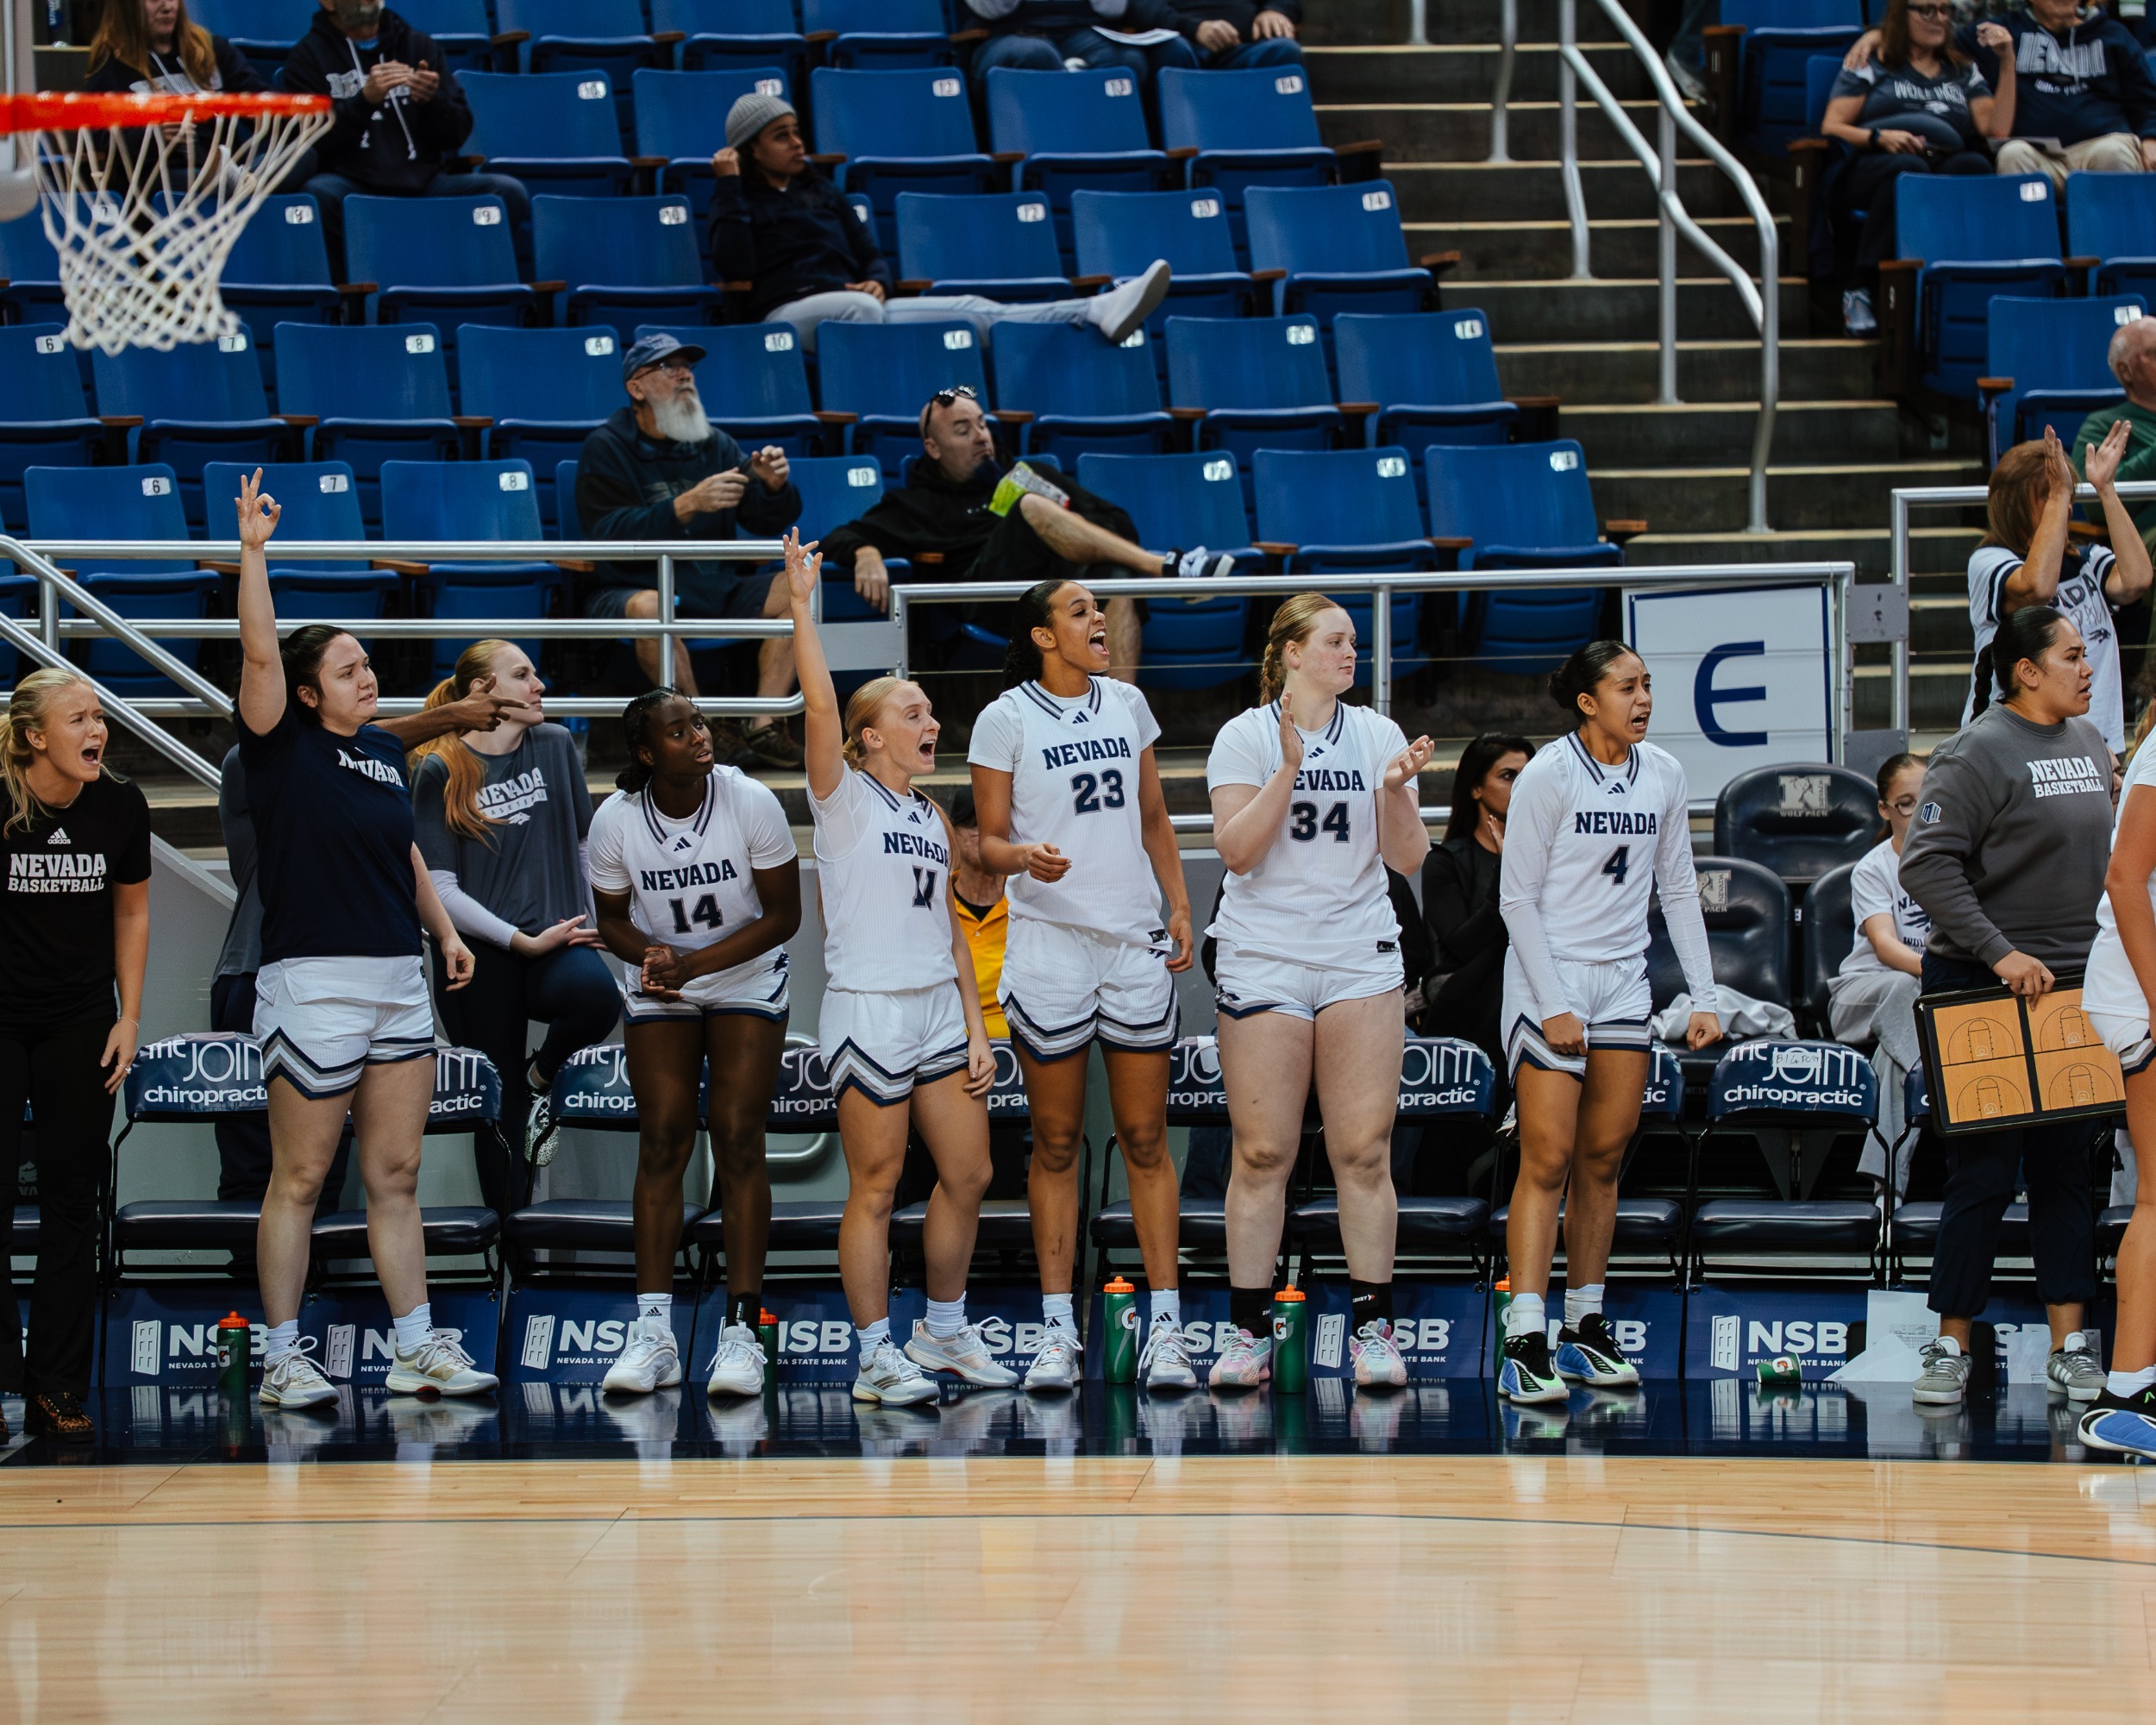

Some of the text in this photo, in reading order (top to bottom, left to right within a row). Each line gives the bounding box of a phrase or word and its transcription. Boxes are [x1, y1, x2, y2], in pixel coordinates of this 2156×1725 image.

[46, 338, 53, 352] 6
[228, 337, 235, 349] 7
[416, 337, 423, 350] 8
[773, 336, 784, 349] 10
[153, 480, 160, 493] 6
[329, 477, 336, 491] 7
[510, 475, 517, 489] 8
[856, 470, 868, 485] 10
[1694, 641, 1767, 746] E
[1042, 737, 1131, 770] NEVADA
[1292, 769, 1366, 792] EVADA
[2027, 756, 2099, 783] NEVADA
[474, 767, 544, 809] NEVADA
[1069, 768, 1125, 816] 23
[2033, 779, 2104, 799] BASKETBALL
[1290, 800, 1351, 844] 34
[1575, 812, 1657, 835] NEVADA
[9, 854, 107, 878] NEVADA
[641, 859, 737, 891] NEVADA
[1601, 844, 1630, 886] 4
[8, 877, 104, 894] BASKETBALL
[668, 893, 724, 934] 14
[183, 1042, 265, 1082] JOIN
[437, 1053, 486, 1092] INT
[1401, 1045, 1480, 1086] OINT
[1763, 1047, 1869, 1087] JOINT
[565, 1091, 636, 1111] chirop
[1400, 1087, 1476, 1109] practic
[1724, 1085, 1863, 1106] chiropractic
[978, 1322, 1046, 1354] SB
[1273, 1317, 1287, 1339] G
[1394, 1318, 1450, 1351] SB
[1748, 1320, 1849, 1353] NSB
[217, 1346, 230, 1367] G
